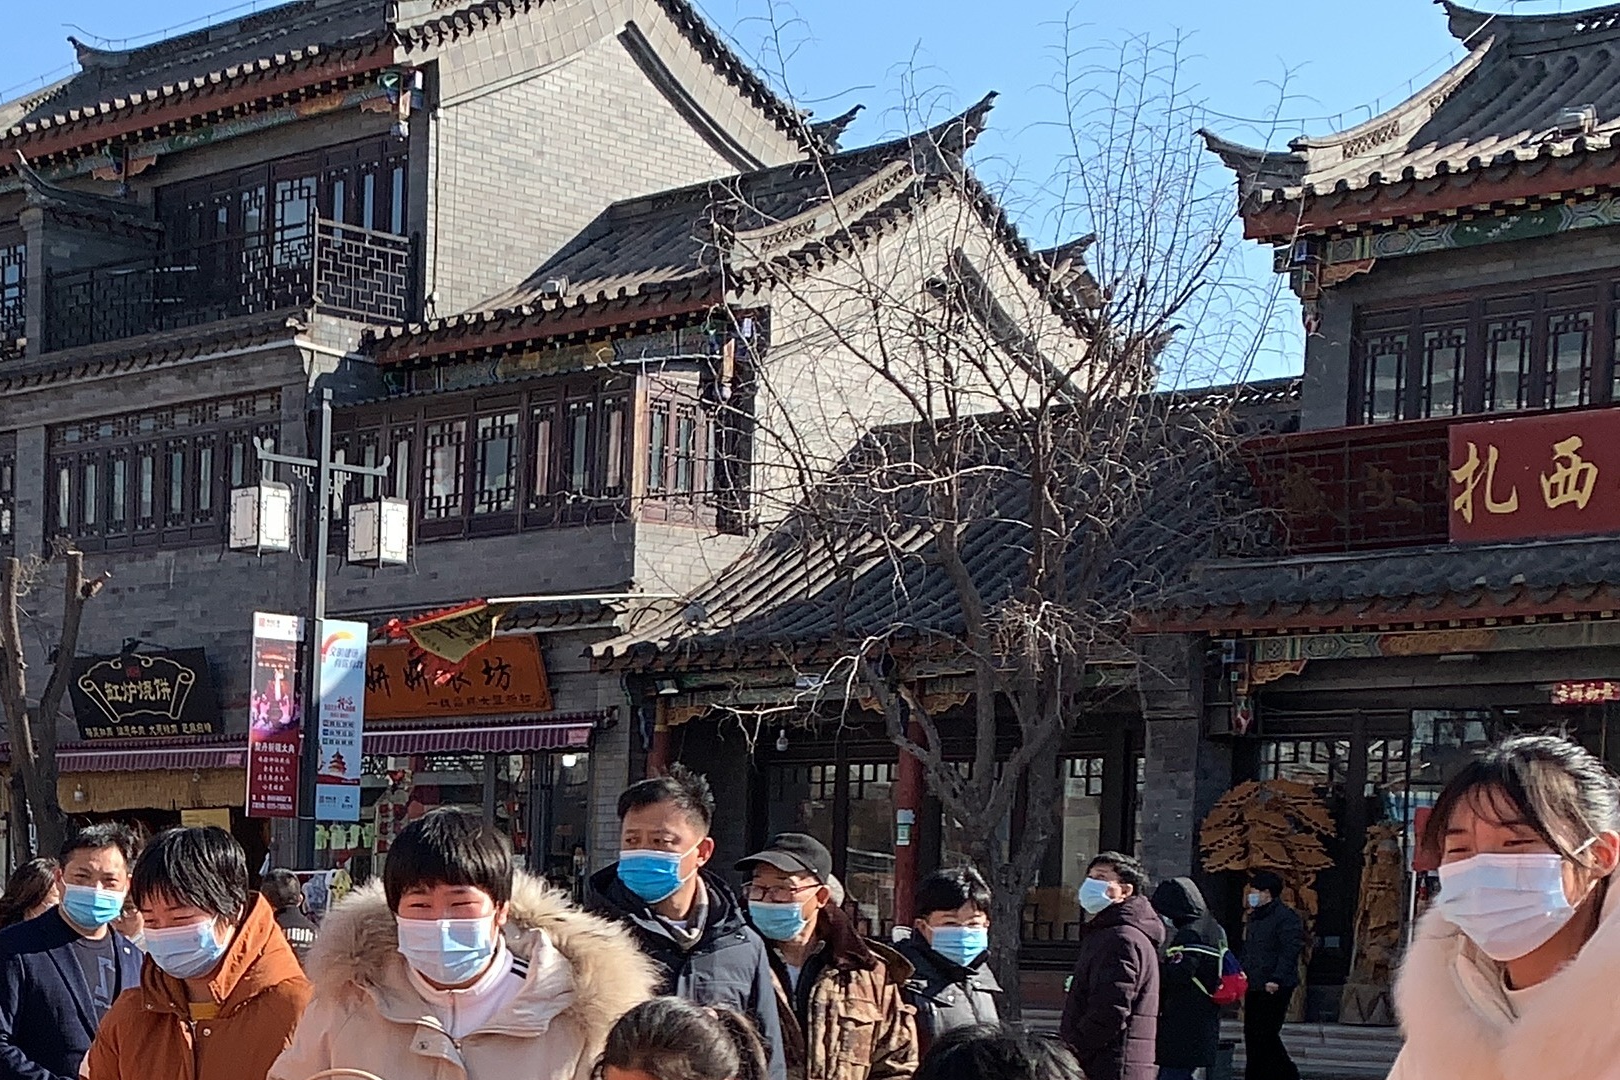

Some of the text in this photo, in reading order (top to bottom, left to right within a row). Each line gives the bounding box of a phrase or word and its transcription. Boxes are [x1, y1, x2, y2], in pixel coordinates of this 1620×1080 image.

[1450, 435, 1599, 524] 扎西
[104, 677, 173, 704] 缸炉烧饼
